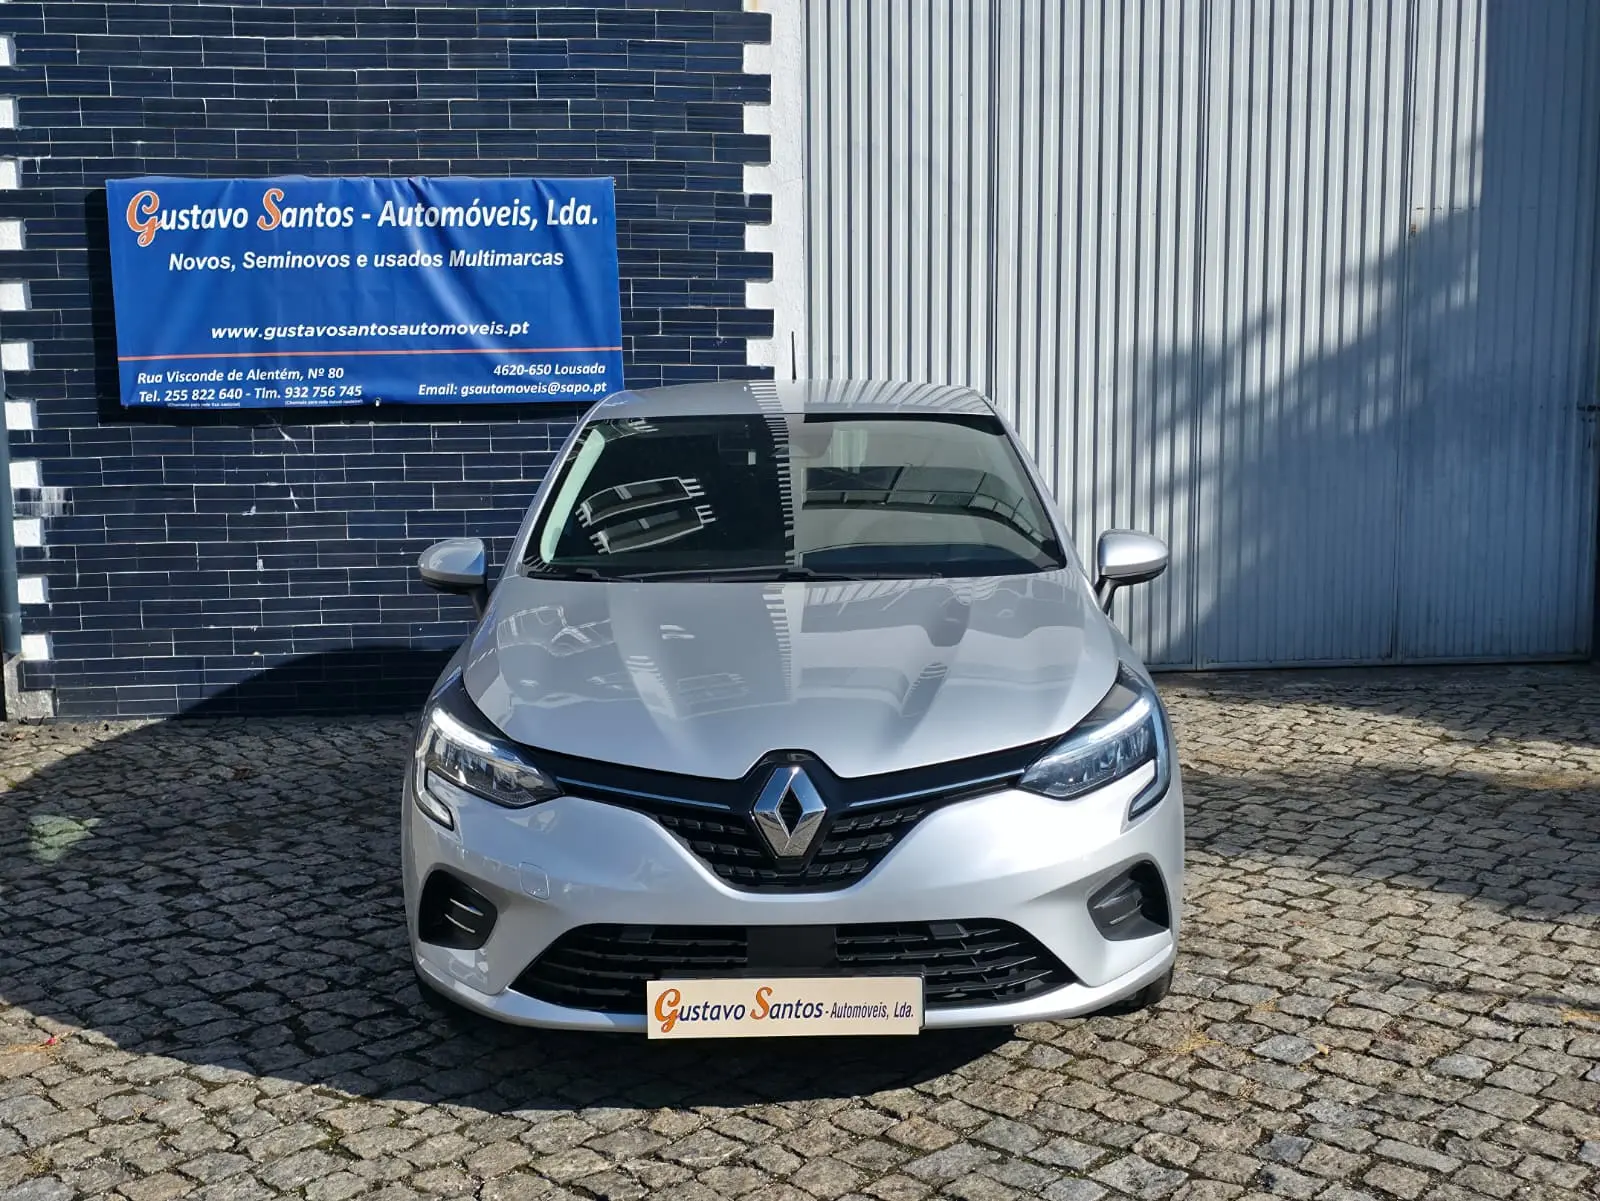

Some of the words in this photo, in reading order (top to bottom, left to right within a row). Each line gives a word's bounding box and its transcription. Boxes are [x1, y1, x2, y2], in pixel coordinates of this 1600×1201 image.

[126, 190, 249, 247] Gustavo
[256, 188, 354, 231] Santos
[377, 198, 538, 231] Automóveis,
[546, 197, 598, 225] Lda.
[169, 253, 236, 272] Novos,
[242, 251, 350, 269] Seminovos
[356, 254, 368, 267] e
[373, 250, 443, 267] usados
[449, 250, 564, 267] Multimarcas
[211, 321, 530, 340] www.gustavosantosautomoveis.pt
[137, 372, 163, 384] Rua
[166, 369, 224, 383] Visconde
[227, 369, 244, 381] de
[246, 368, 304, 382] Alentém,
[328, 367, 344, 379] 80
[493, 363, 551, 376] 4620-650
[554, 363, 606, 375] Lousada
[139, 391, 161, 402] Tel.
[164, 390, 188, 402] 255
[191, 389, 216, 401] 822
[218, 388, 243, 400] 640
[254, 387, 281, 399] Tlm.
[284, 387, 309, 399] 932
[312, 386, 336, 398] 756
[340, 385, 363, 397] 745
[418, 384, 458, 396] Email:
[461, 382, 607, 397] gsautomoveis@sapo.pt
[654, 988, 746, 1033] Gustavo
[750, 986, 824, 1020] Santos
[830, 1001, 889, 1021] Automóveis,
[893, 1001, 914, 1018] Lda.
